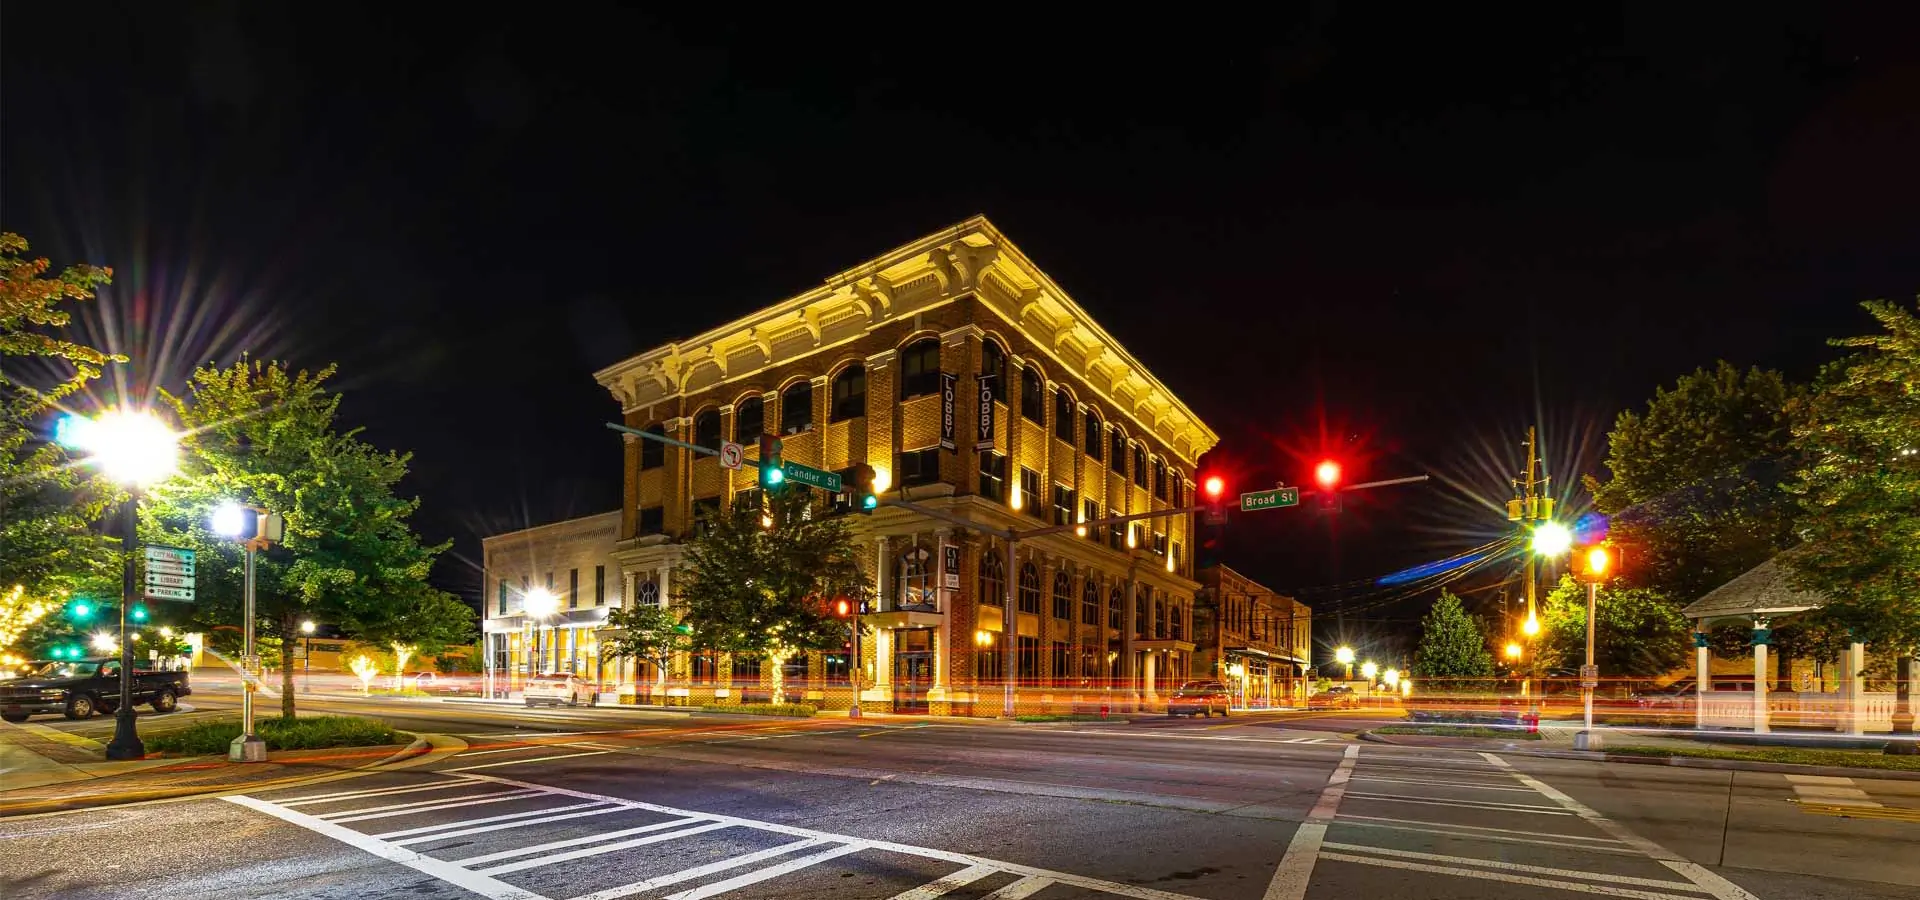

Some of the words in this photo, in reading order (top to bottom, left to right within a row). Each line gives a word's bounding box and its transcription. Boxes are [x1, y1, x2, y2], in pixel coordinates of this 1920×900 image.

[945, 377, 953, 437] LOBBY
[981, 379, 991, 438] LOBBY
[788, 465, 819, 483] Candler
[827, 477, 836, 487] St
[1246, 494, 1275, 506] Broad
[1282, 493, 1293, 502] St
[153, 551, 165, 559] CITY
[160, 577, 184, 585] LIBRARY
[157, 588, 182, 597] PARKING
